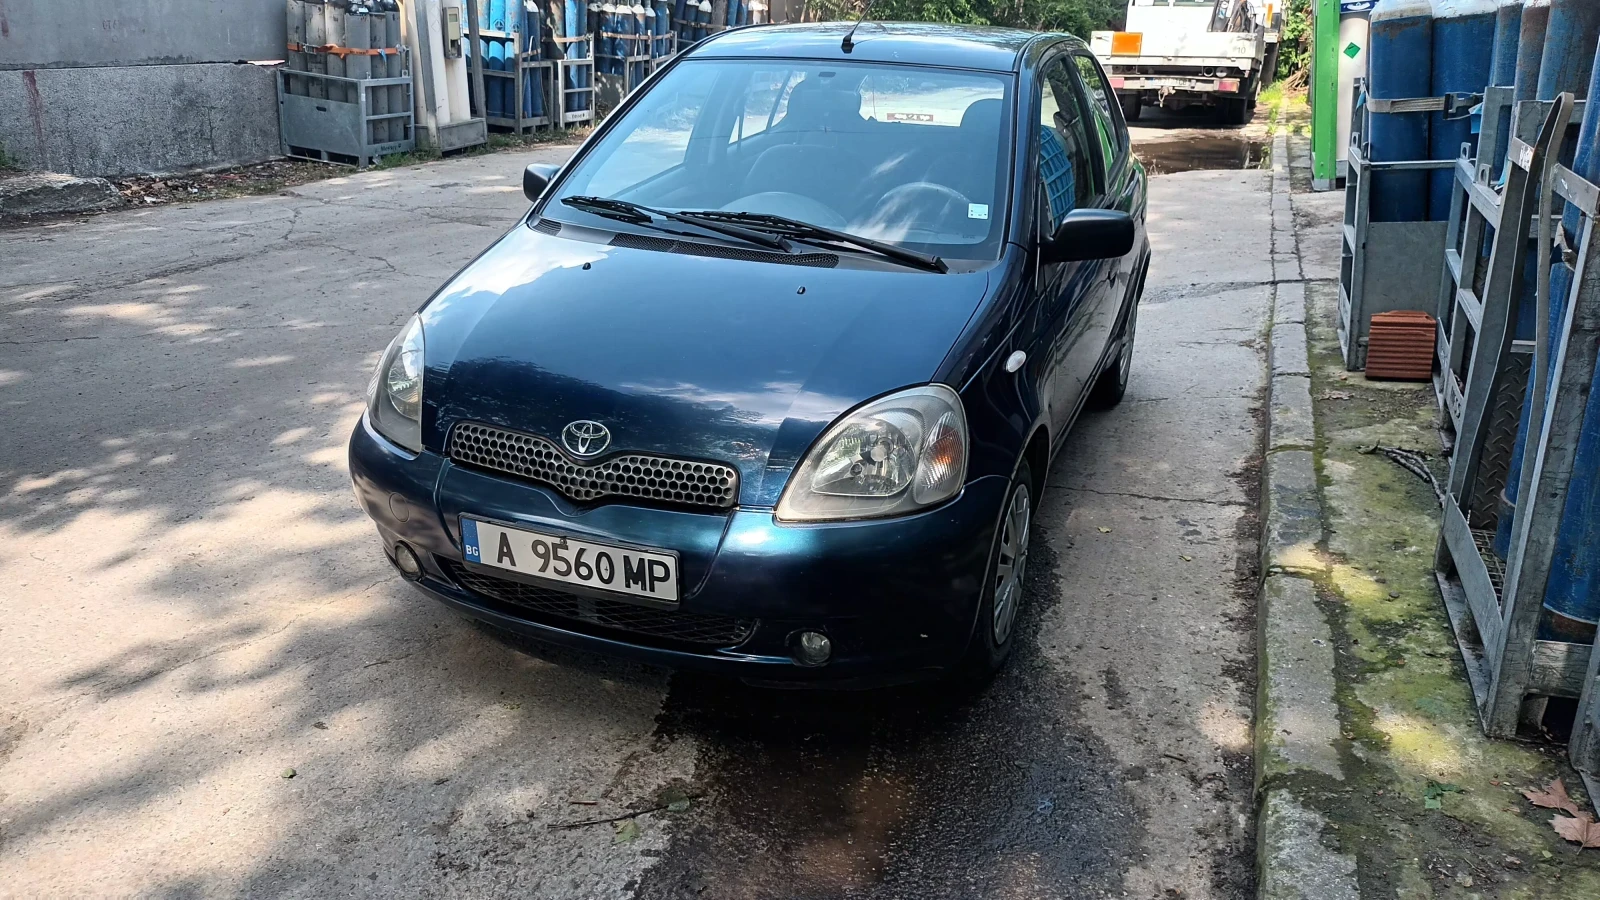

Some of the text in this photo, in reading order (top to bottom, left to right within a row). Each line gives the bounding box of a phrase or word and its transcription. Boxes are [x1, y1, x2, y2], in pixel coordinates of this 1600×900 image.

[466, 531, 671, 593] BG A 9560 MP
